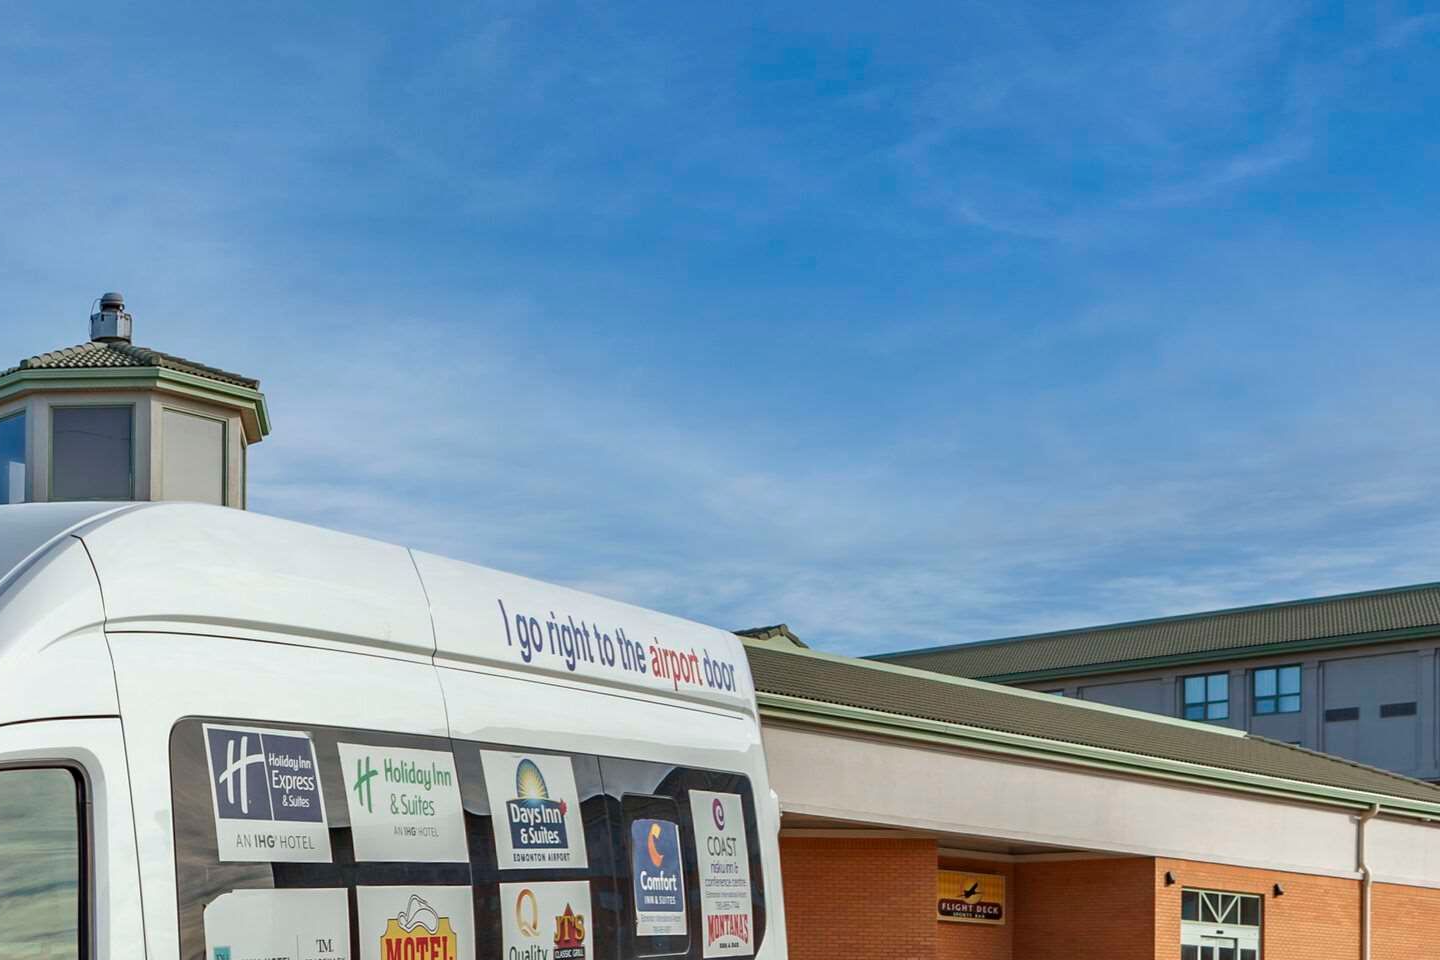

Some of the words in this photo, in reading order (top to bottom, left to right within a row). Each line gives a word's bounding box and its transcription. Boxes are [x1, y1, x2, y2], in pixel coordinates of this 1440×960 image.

[498, 599, 512, 646] I
[516, 613, 542, 663] go
[546, 611, 594, 671] right
[593, 624, 615, 668] to
[616, 628, 647, 673] the
[649, 637, 703, 691] airport
[703, 649, 736, 692] door
[268, 752, 298, 771] Holiday
[298, 756, 311, 769] Inn
[271, 770, 315, 794] Express
[384, 758, 432, 791] Holiday
[432, 762, 452, 786] Inn
[282, 795, 288, 807] &
[289, 795, 310, 808] Suites
[390, 793, 399, 815] &
[400, 794, 435, 816] Suites
[509, 803, 541, 826] Days
[541, 804, 562, 824] Inn
[393, 826, 403, 836] AN
[418, 826, 439, 837] HOTEL
[520, 828, 528, 844] &
[528, 826, 560, 845] Suites
[236, 834, 252, 848] AN
[280, 835, 315, 850] HOTEL
[706, 836, 737, 856] COAST
[513, 853, 546, 862] EDMONTON
[548, 852, 570, 862] AIRPORT
[640, 871, 677, 891] Comfort
[942, 903, 973, 912] FLIGHT
[976, 905, 999, 914] DECK
